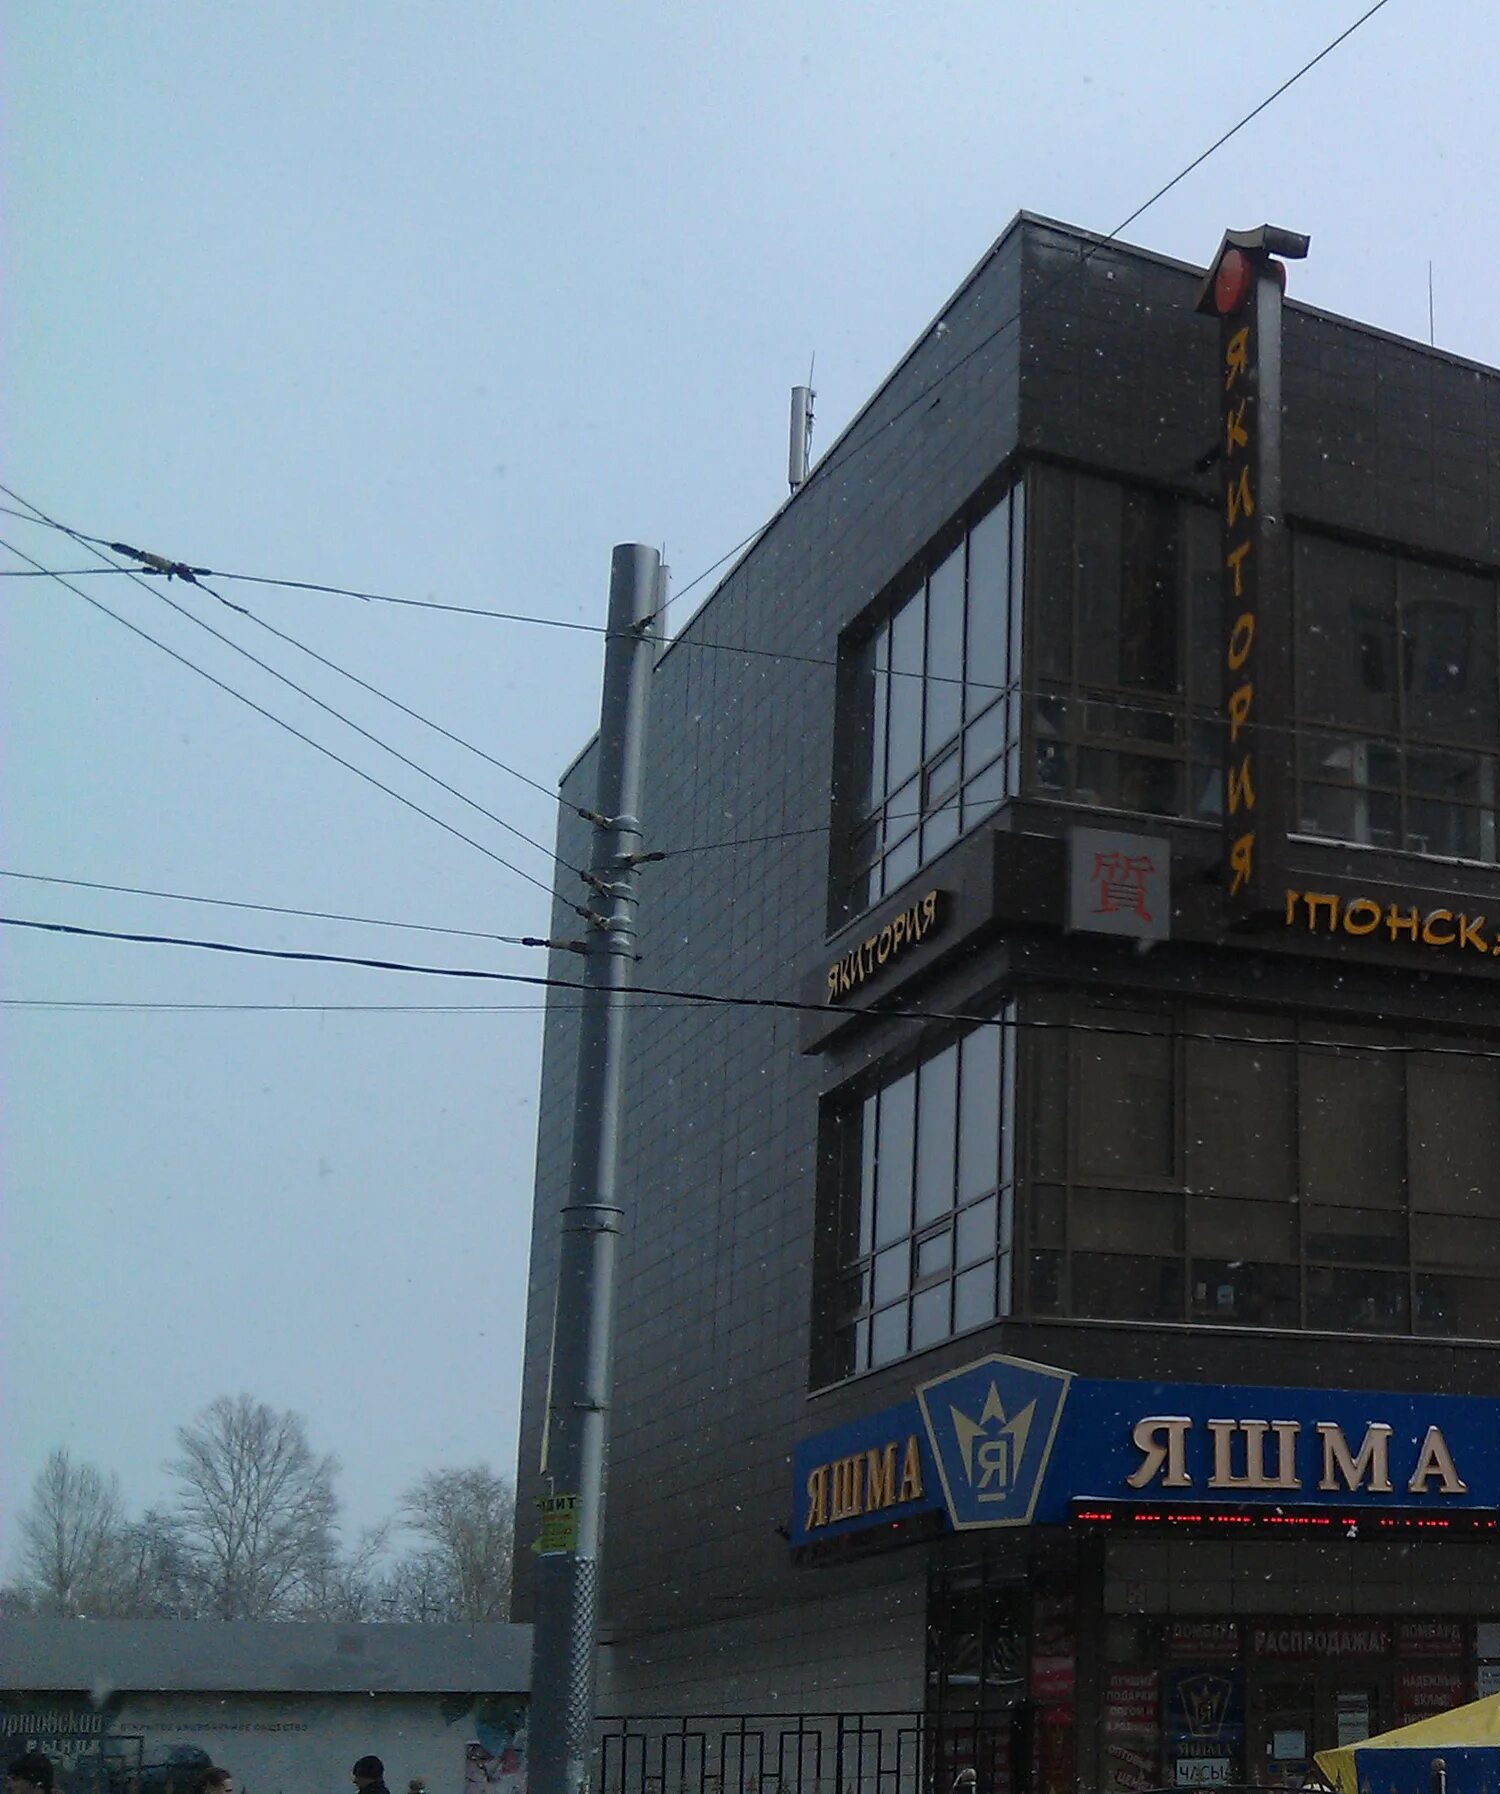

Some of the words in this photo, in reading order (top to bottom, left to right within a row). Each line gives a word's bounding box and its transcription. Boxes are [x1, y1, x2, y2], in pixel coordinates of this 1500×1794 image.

[1227, 326, 1254, 896] ЯКИТОРИЯ
[827, 889, 938, 1004] ЯКИТОРИЯ
[805, 1434, 924, 1531] ЯШМА
[1126, 1415, 1468, 1494] ЯШМА
[1180, 1766, 1224, 1781] ЧАСЫ
